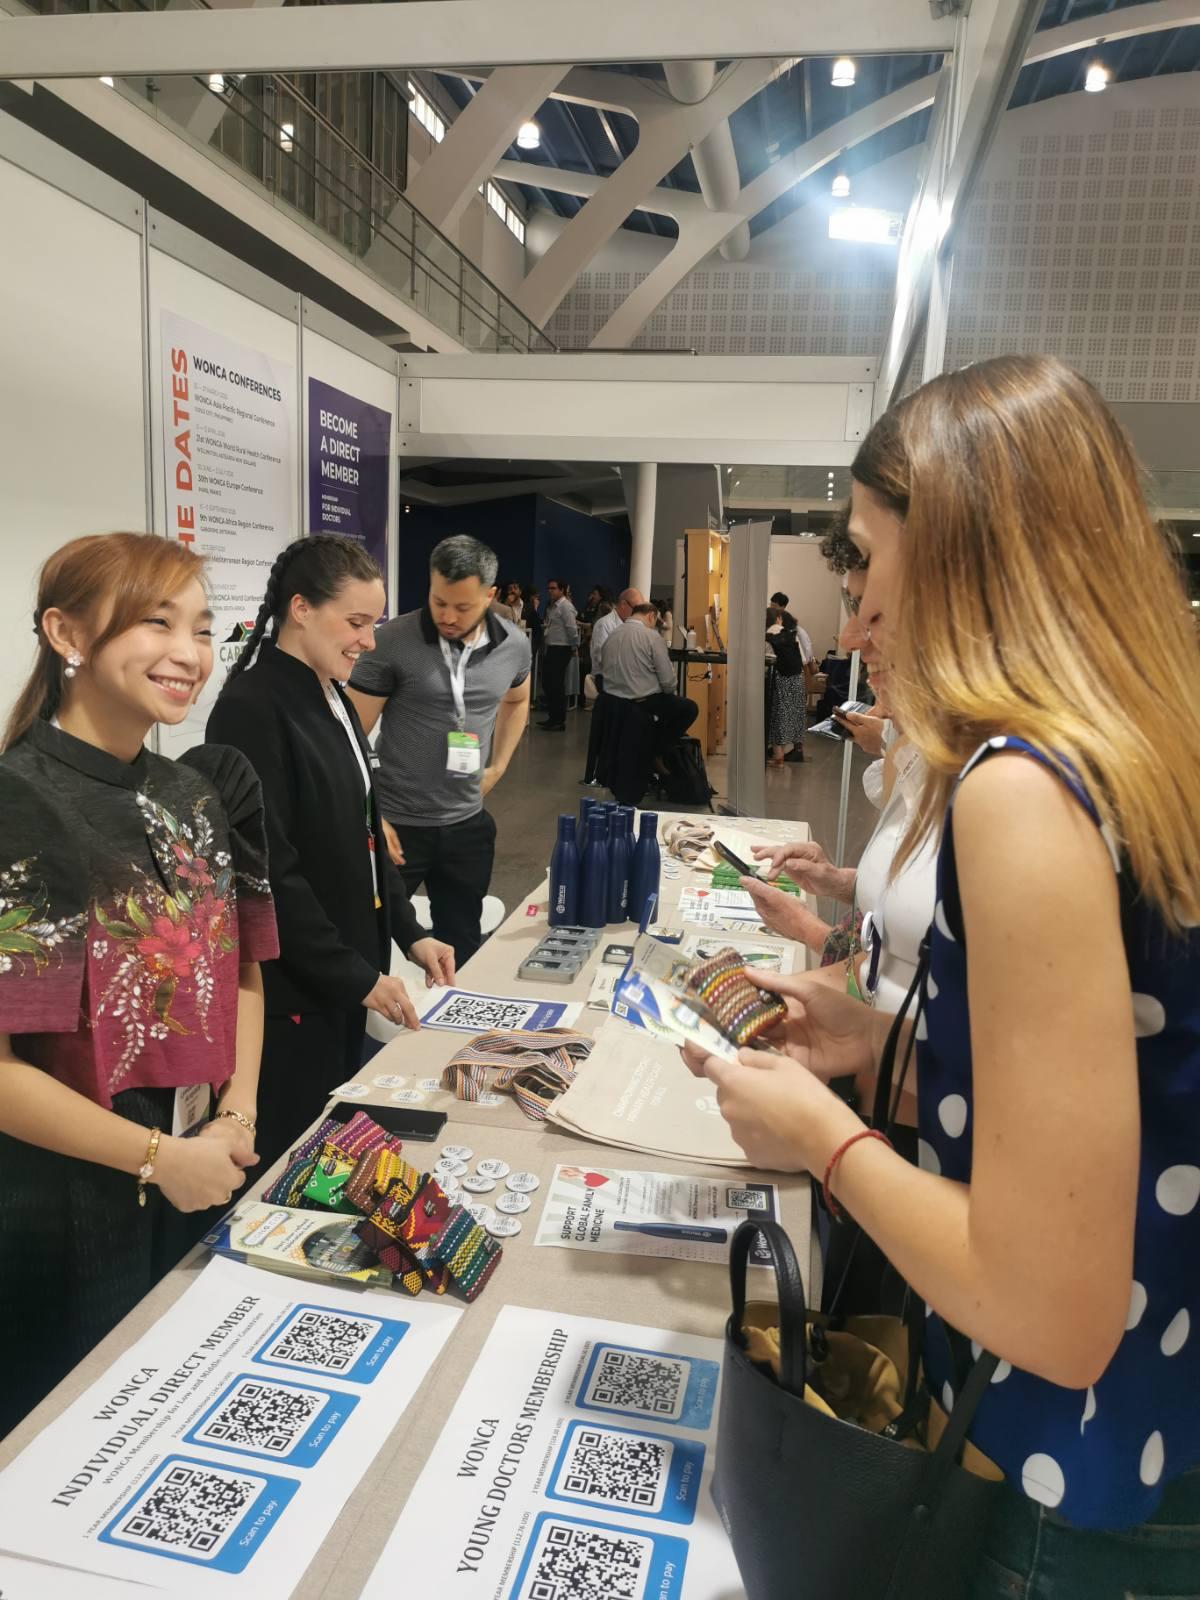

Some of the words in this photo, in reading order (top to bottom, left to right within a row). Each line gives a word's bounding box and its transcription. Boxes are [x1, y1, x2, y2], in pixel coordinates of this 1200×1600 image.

[193, 356, 227, 380] WONCA
[229, 371, 281, 402] CONFERENCES
[171, 347, 192, 491] DATES
[320, 409, 358, 439] BECOME
[320, 435, 328, 452] A
[329, 438, 360, 463] DIRECT
[321, 460, 359, 486] MEMBER
[581, 1187, 595, 1212] FAMILY
[561, 1205, 576, 1240] SUPPORT
[575, 1213, 590, 1242] GLOBAL
[589, 1208, 605, 1243] MEDICINE
[366, 1351, 381, 1366] Scan
[382, 1336, 394, 1347] pay
[51, 1407, 158, 1507] INDIVIDUAL
[149, 1351, 206, 1404] DIRECT
[200, 1296, 260, 1350] MEMBER
[93, 1367, 160, 1421] WONCA
[102, 1455, 133, 1485] WONCA
[129, 1411, 171, 1456] Membership
[168, 1402, 180, 1416] for
[180, 1391, 193, 1404] Low
[191, 1379, 204, 1392] and
[309, 1429, 326, 1448] Scan
[328, 1411, 342, 1424] pay
[456, 1418, 499, 1478] WONCA
[456, 1505, 501, 1573] YOUNG
[487, 1422, 533, 1501] DOCTORS
[520, 1328, 568, 1421] MEMBERSHIP
[676, 1483, 689, 1501] Scan
[684, 1461, 694, 1475] pay
[239, 1523, 259, 1547] Scan
[254, 1515, 266, 1525] to
[263, 1499, 278, 1516] pay
[498, 1546, 516, 1587] MEMBERSHIP
[660, 1579, 671, 1588] to
[664, 1560, 677, 1578] pay
